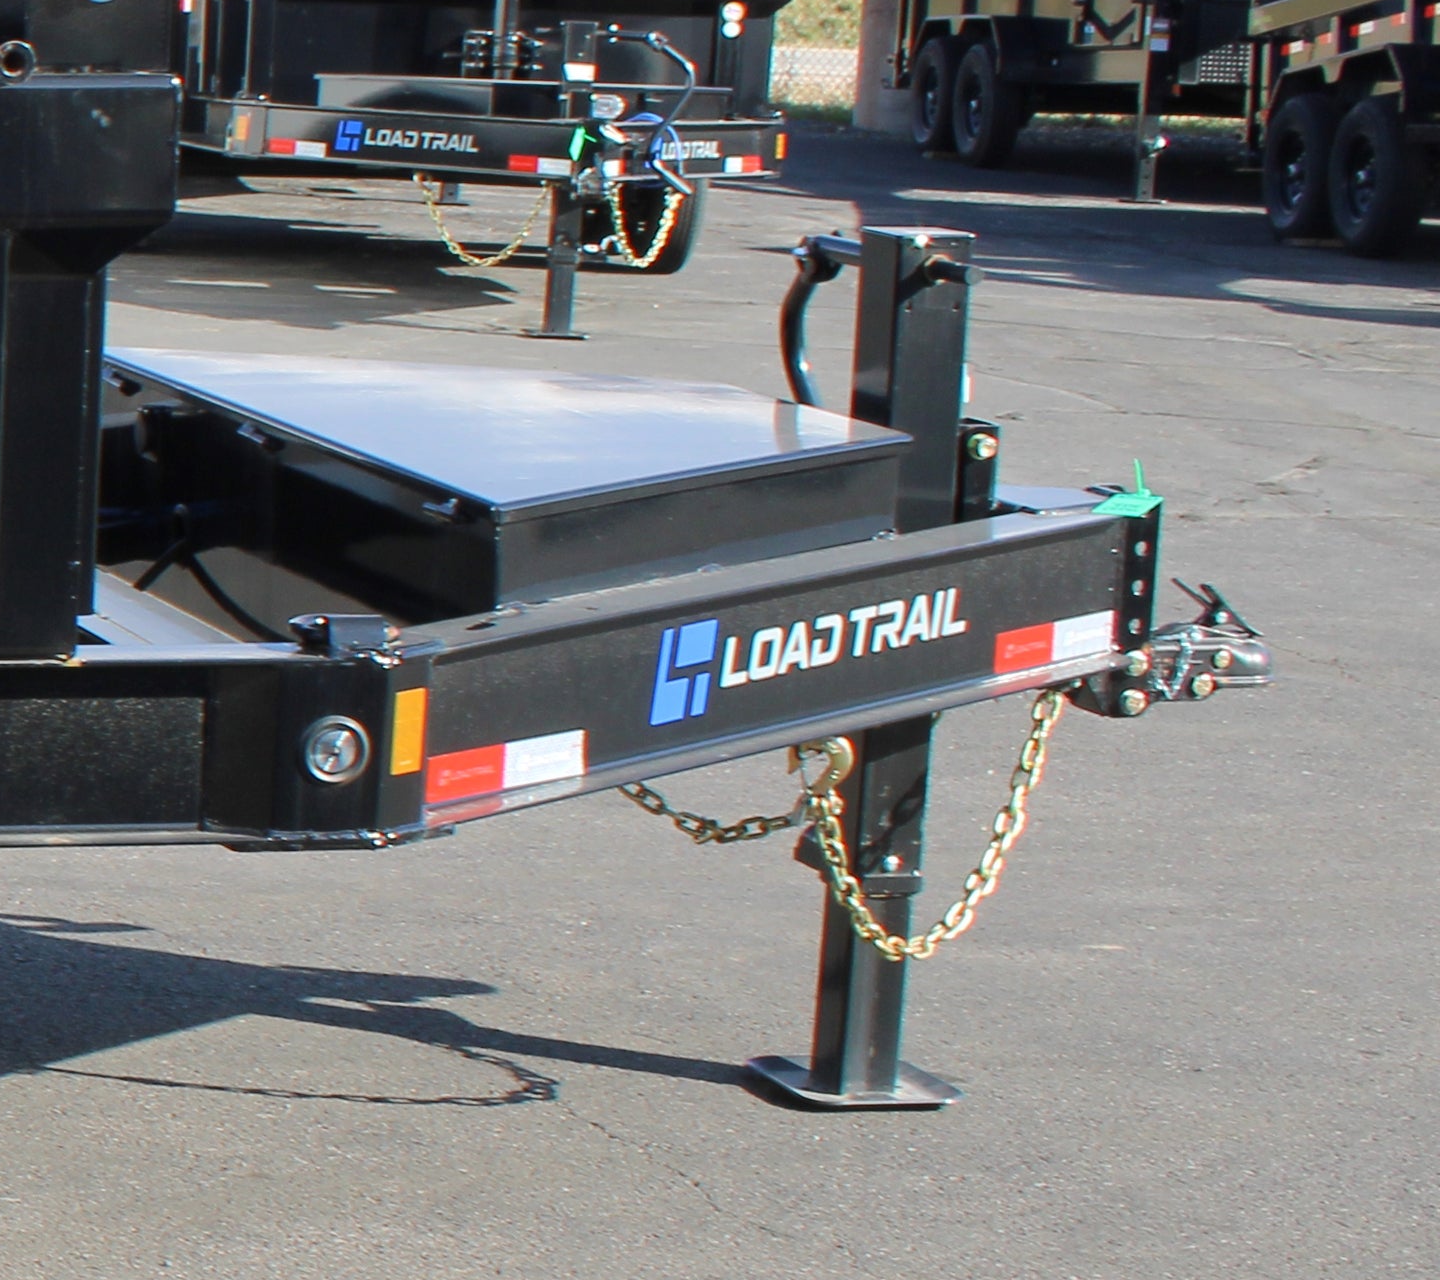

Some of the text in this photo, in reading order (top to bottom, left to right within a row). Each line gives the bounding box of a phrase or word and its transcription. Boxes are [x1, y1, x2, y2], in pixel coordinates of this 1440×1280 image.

[363, 128, 479, 153] LOAD TRAIL
[690, 140, 721, 159] TRAIL
[718, 586, 969, 689] LOAD TRAIL
